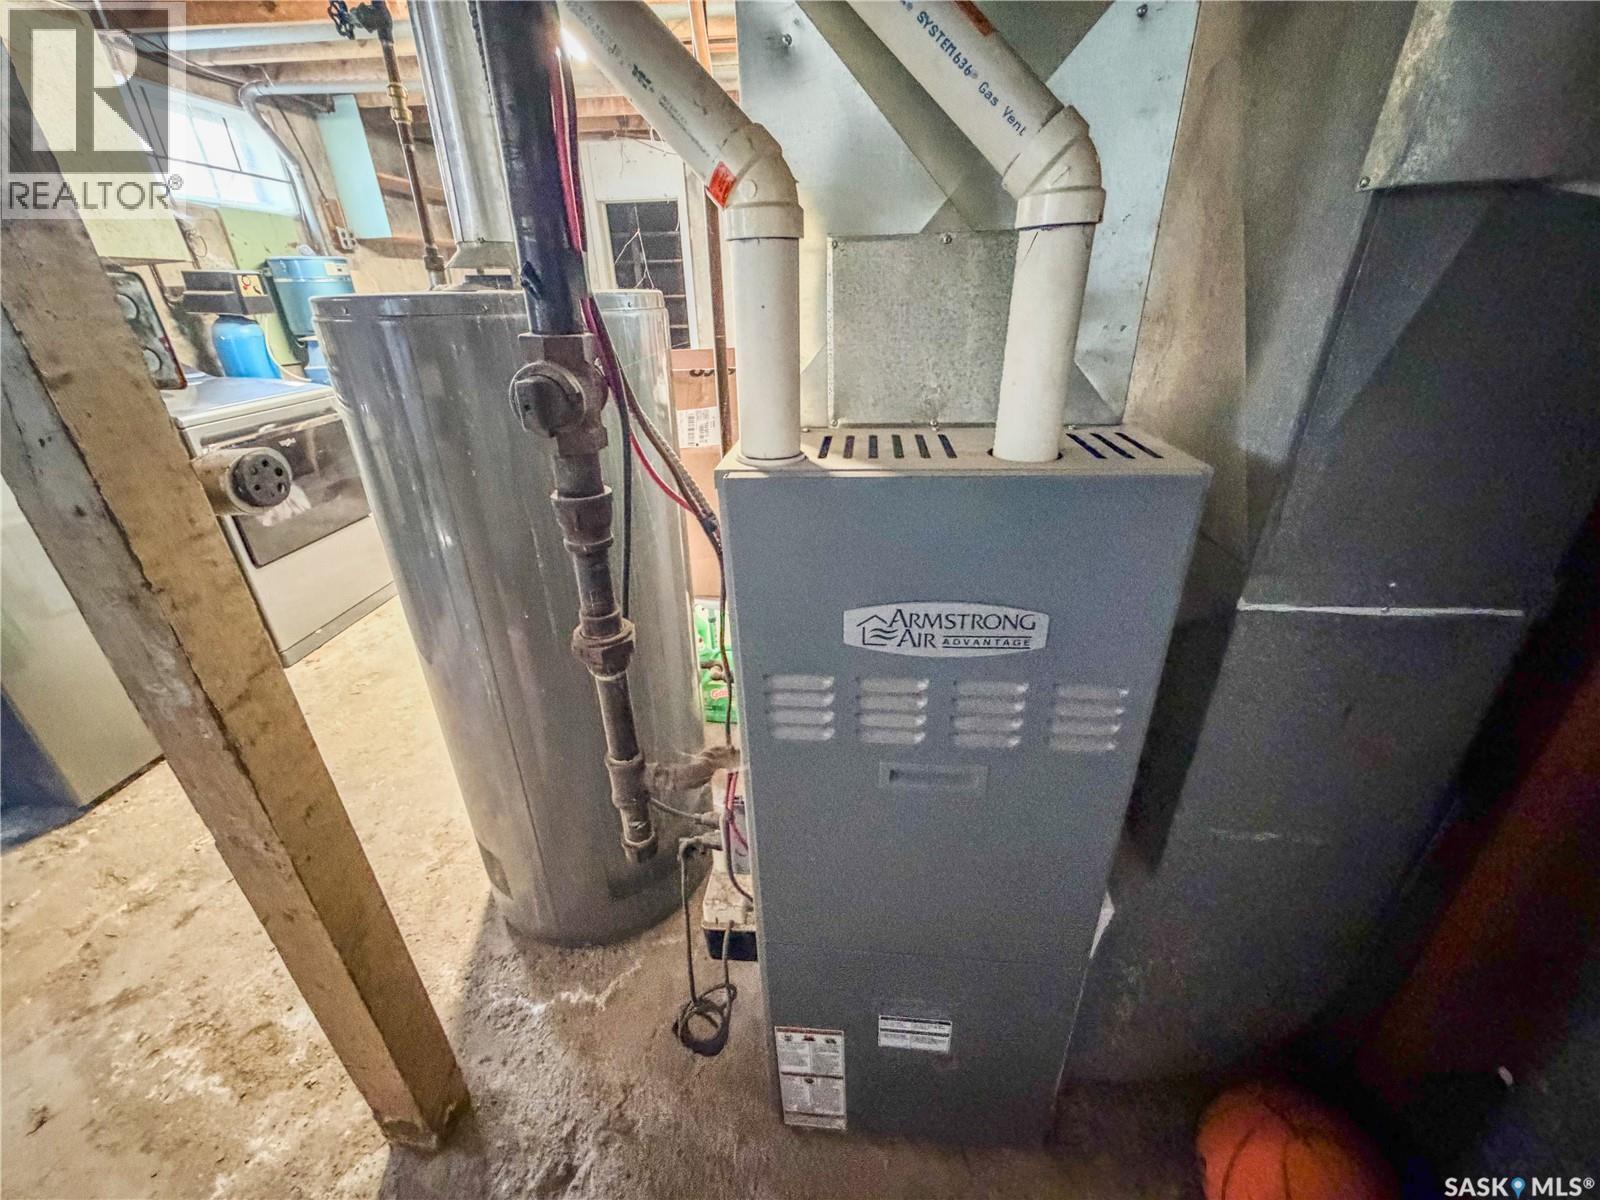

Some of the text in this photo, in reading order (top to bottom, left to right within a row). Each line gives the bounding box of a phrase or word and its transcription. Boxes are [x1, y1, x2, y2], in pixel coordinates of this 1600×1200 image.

[977, 81, 1000, 107] Gas
[1002, 105, 1028, 137] Vent
[888, 608, 1036, 630] ARMSTRONG
[896, 628, 1031, 648] AIR ADVANTAGE
